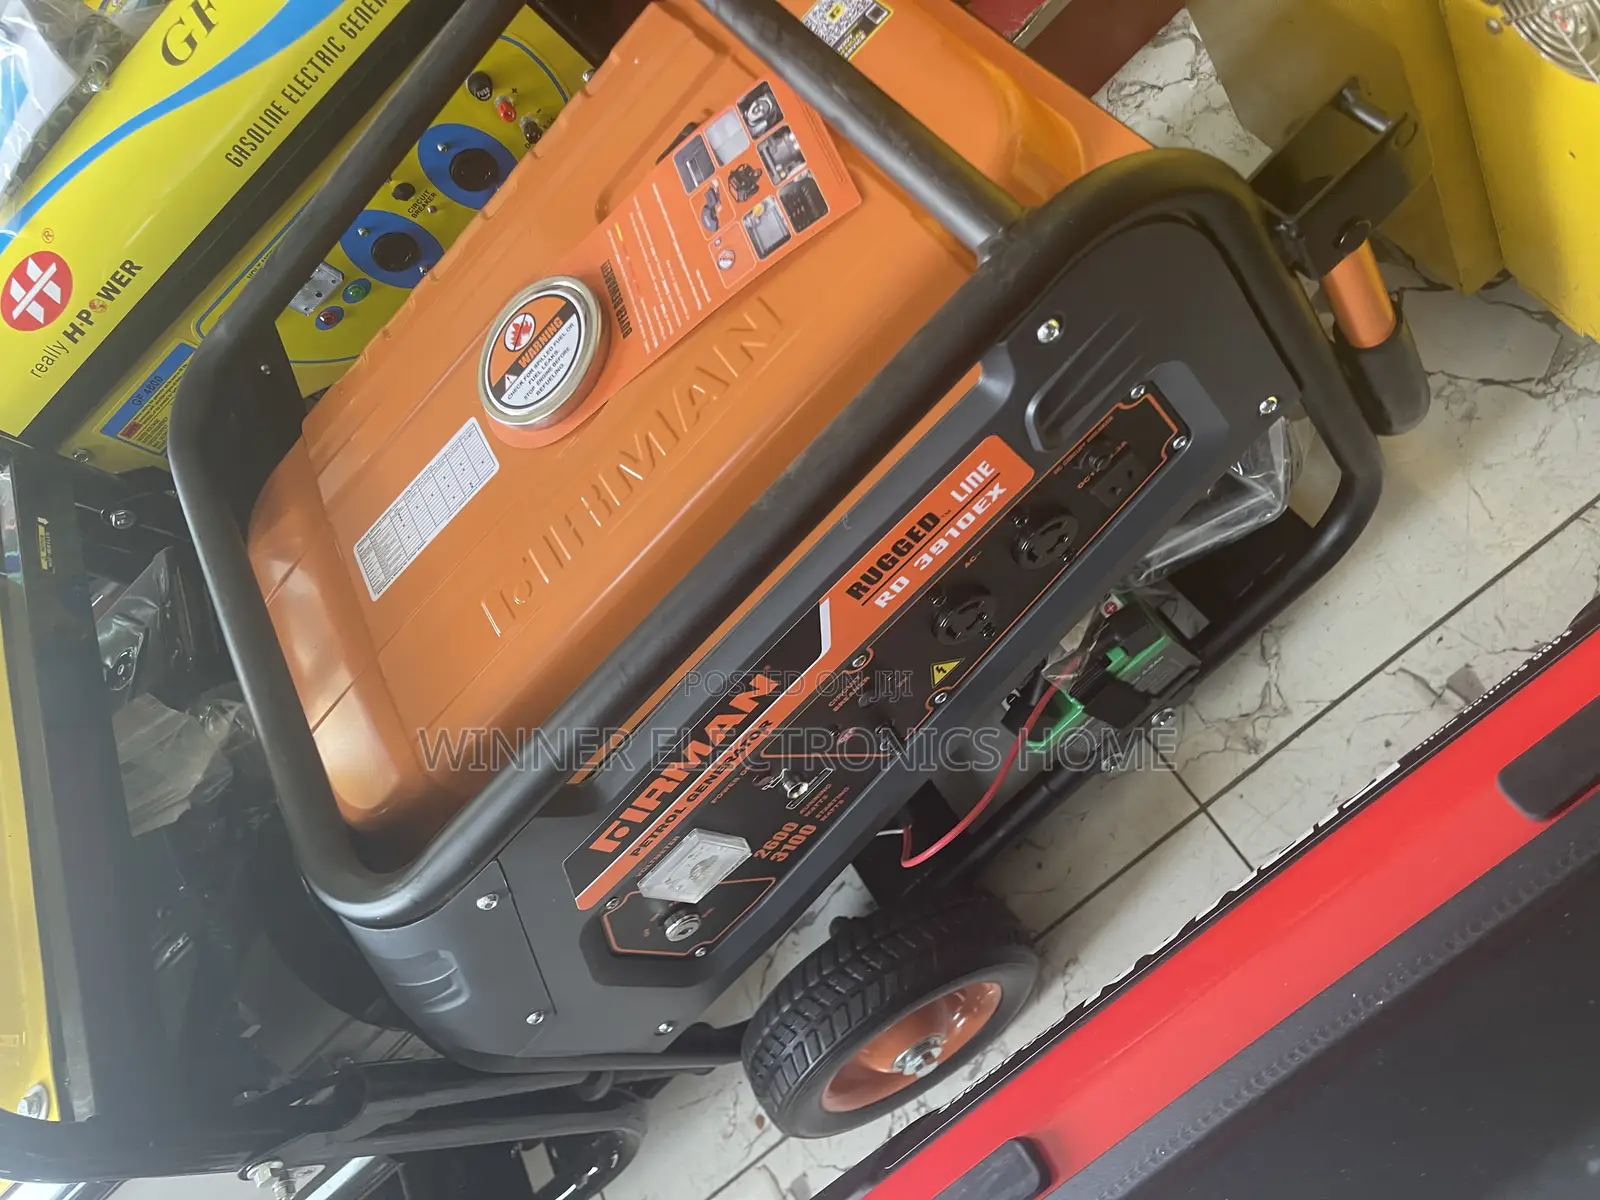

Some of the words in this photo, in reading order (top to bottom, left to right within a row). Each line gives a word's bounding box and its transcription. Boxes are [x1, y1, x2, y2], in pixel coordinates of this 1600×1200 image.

[224, 100, 290, 168] GASOLINE
[281, 36, 346, 105] ELECTRIC
[407, 189, 431, 214] CIRCUIT
[411, 192, 437, 219] BREAKER
[616, 304, 633, 340] BUYER
[30, 340, 70, 379] really
[518, 316, 564, 369] WARNING
[131, 393, 146, 407] GF
[845, 511, 941, 601] RUGGED
[950, 459, 996, 503] LINE
[912, 481, 1008, 571] 3910EX
[630, 804, 688, 857] PETROL
[686, 719, 773, 803] GENERATOR
[753, 822, 800, 859] 2600
[769, 824, 818, 863] 3100
